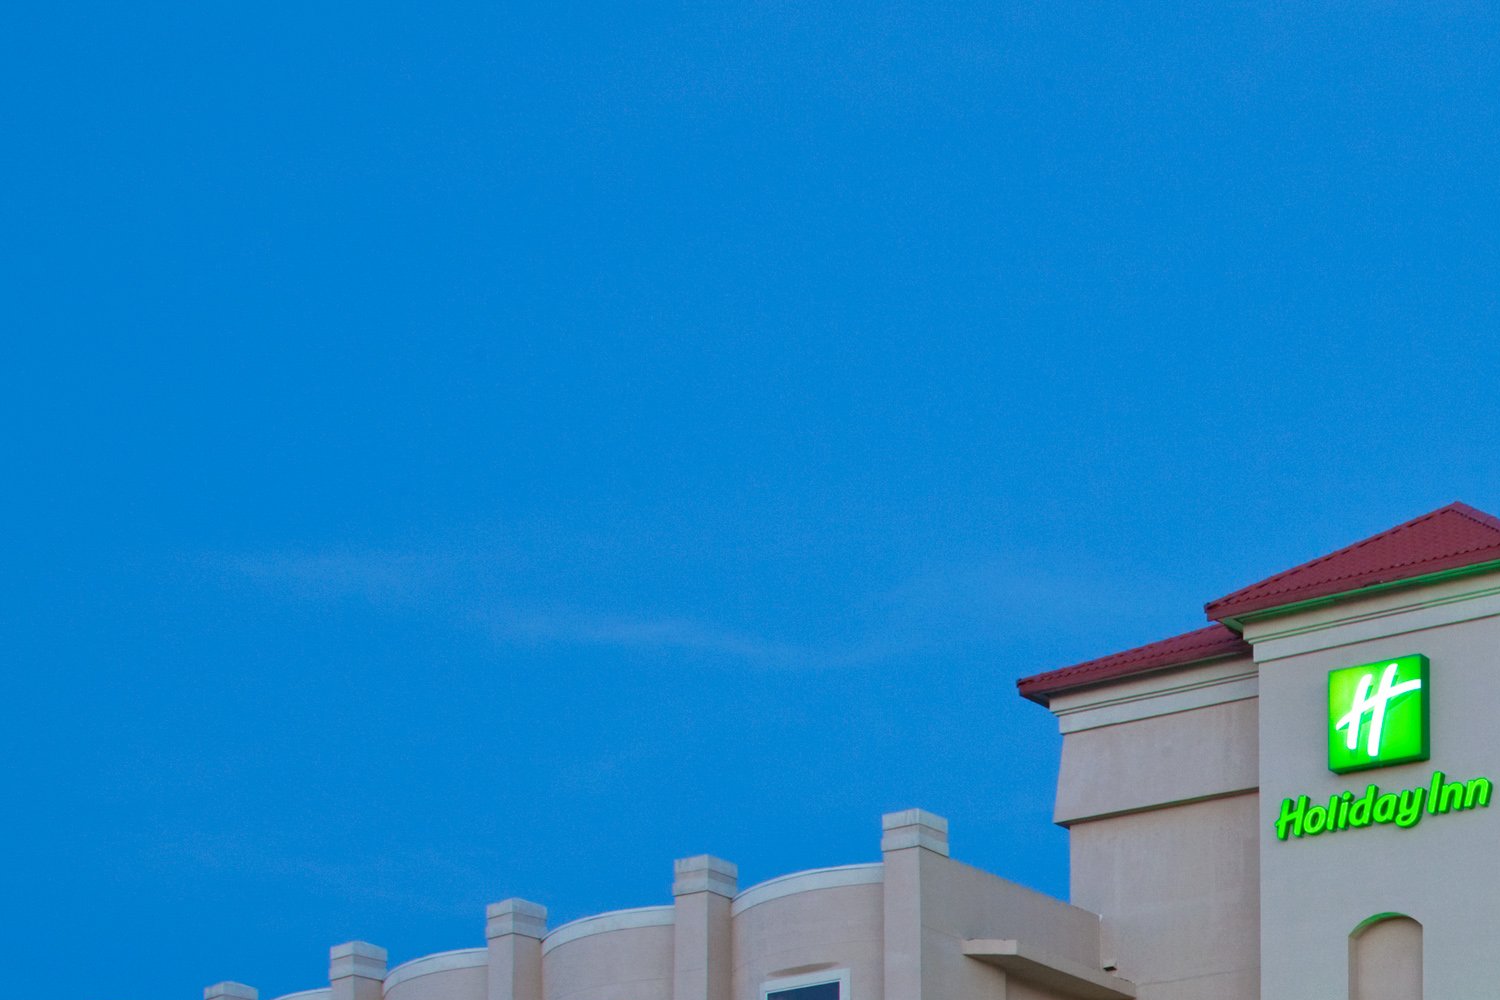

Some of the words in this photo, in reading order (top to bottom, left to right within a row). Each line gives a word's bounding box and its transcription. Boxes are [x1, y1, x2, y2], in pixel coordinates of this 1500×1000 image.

[1336, 663, 1421, 757] H
[1275, 784, 1427, 841] Holiday
[1427, 771, 1493, 815] Inn
